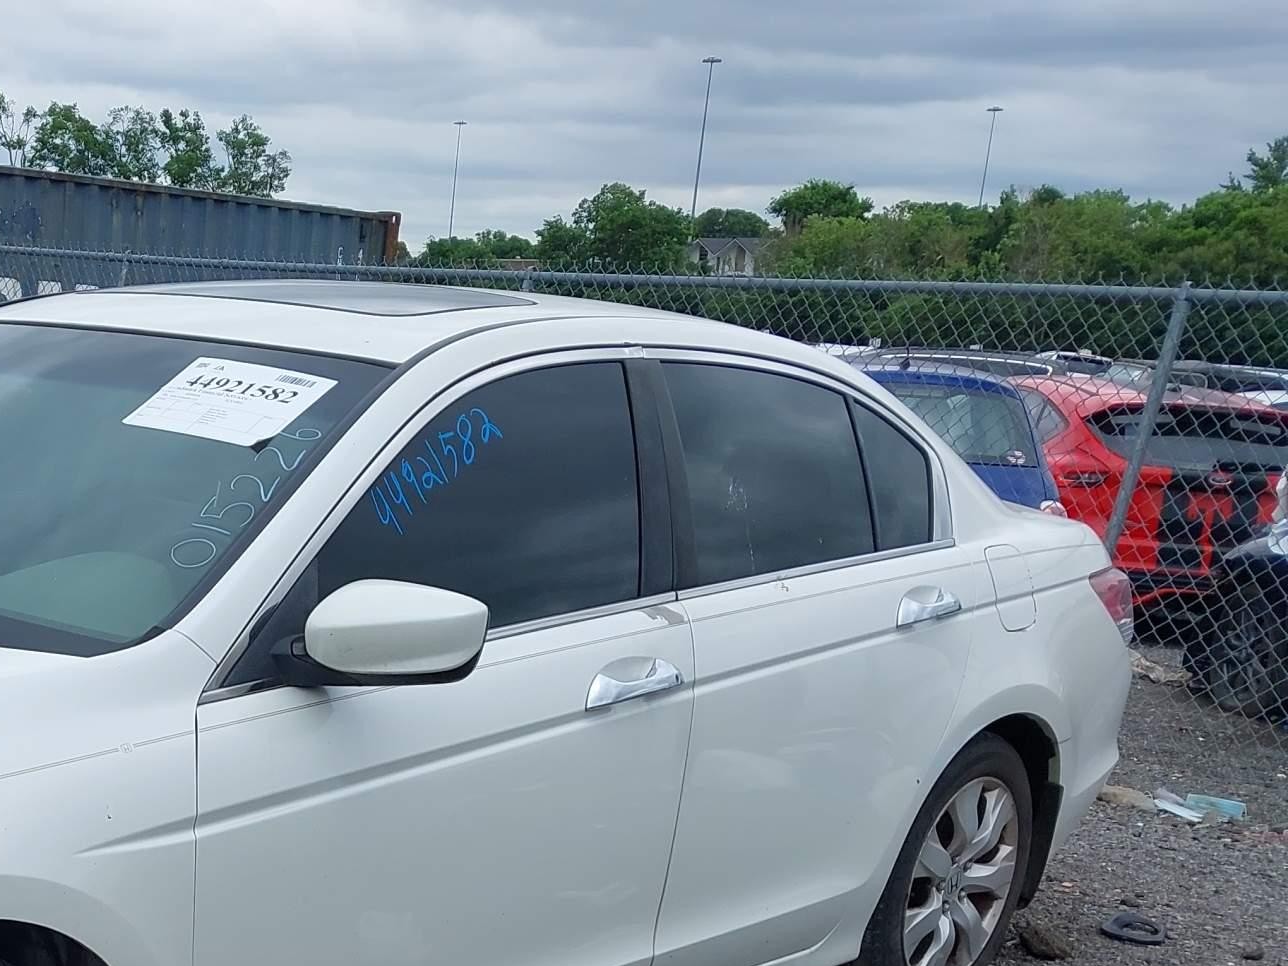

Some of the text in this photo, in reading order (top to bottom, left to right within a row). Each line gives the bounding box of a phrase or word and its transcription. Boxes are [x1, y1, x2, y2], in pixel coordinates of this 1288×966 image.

[186, 374, 300, 404] 44921582
[170, 428, 323, 568] 015226
[370, 407, 504, 535] 44921582
